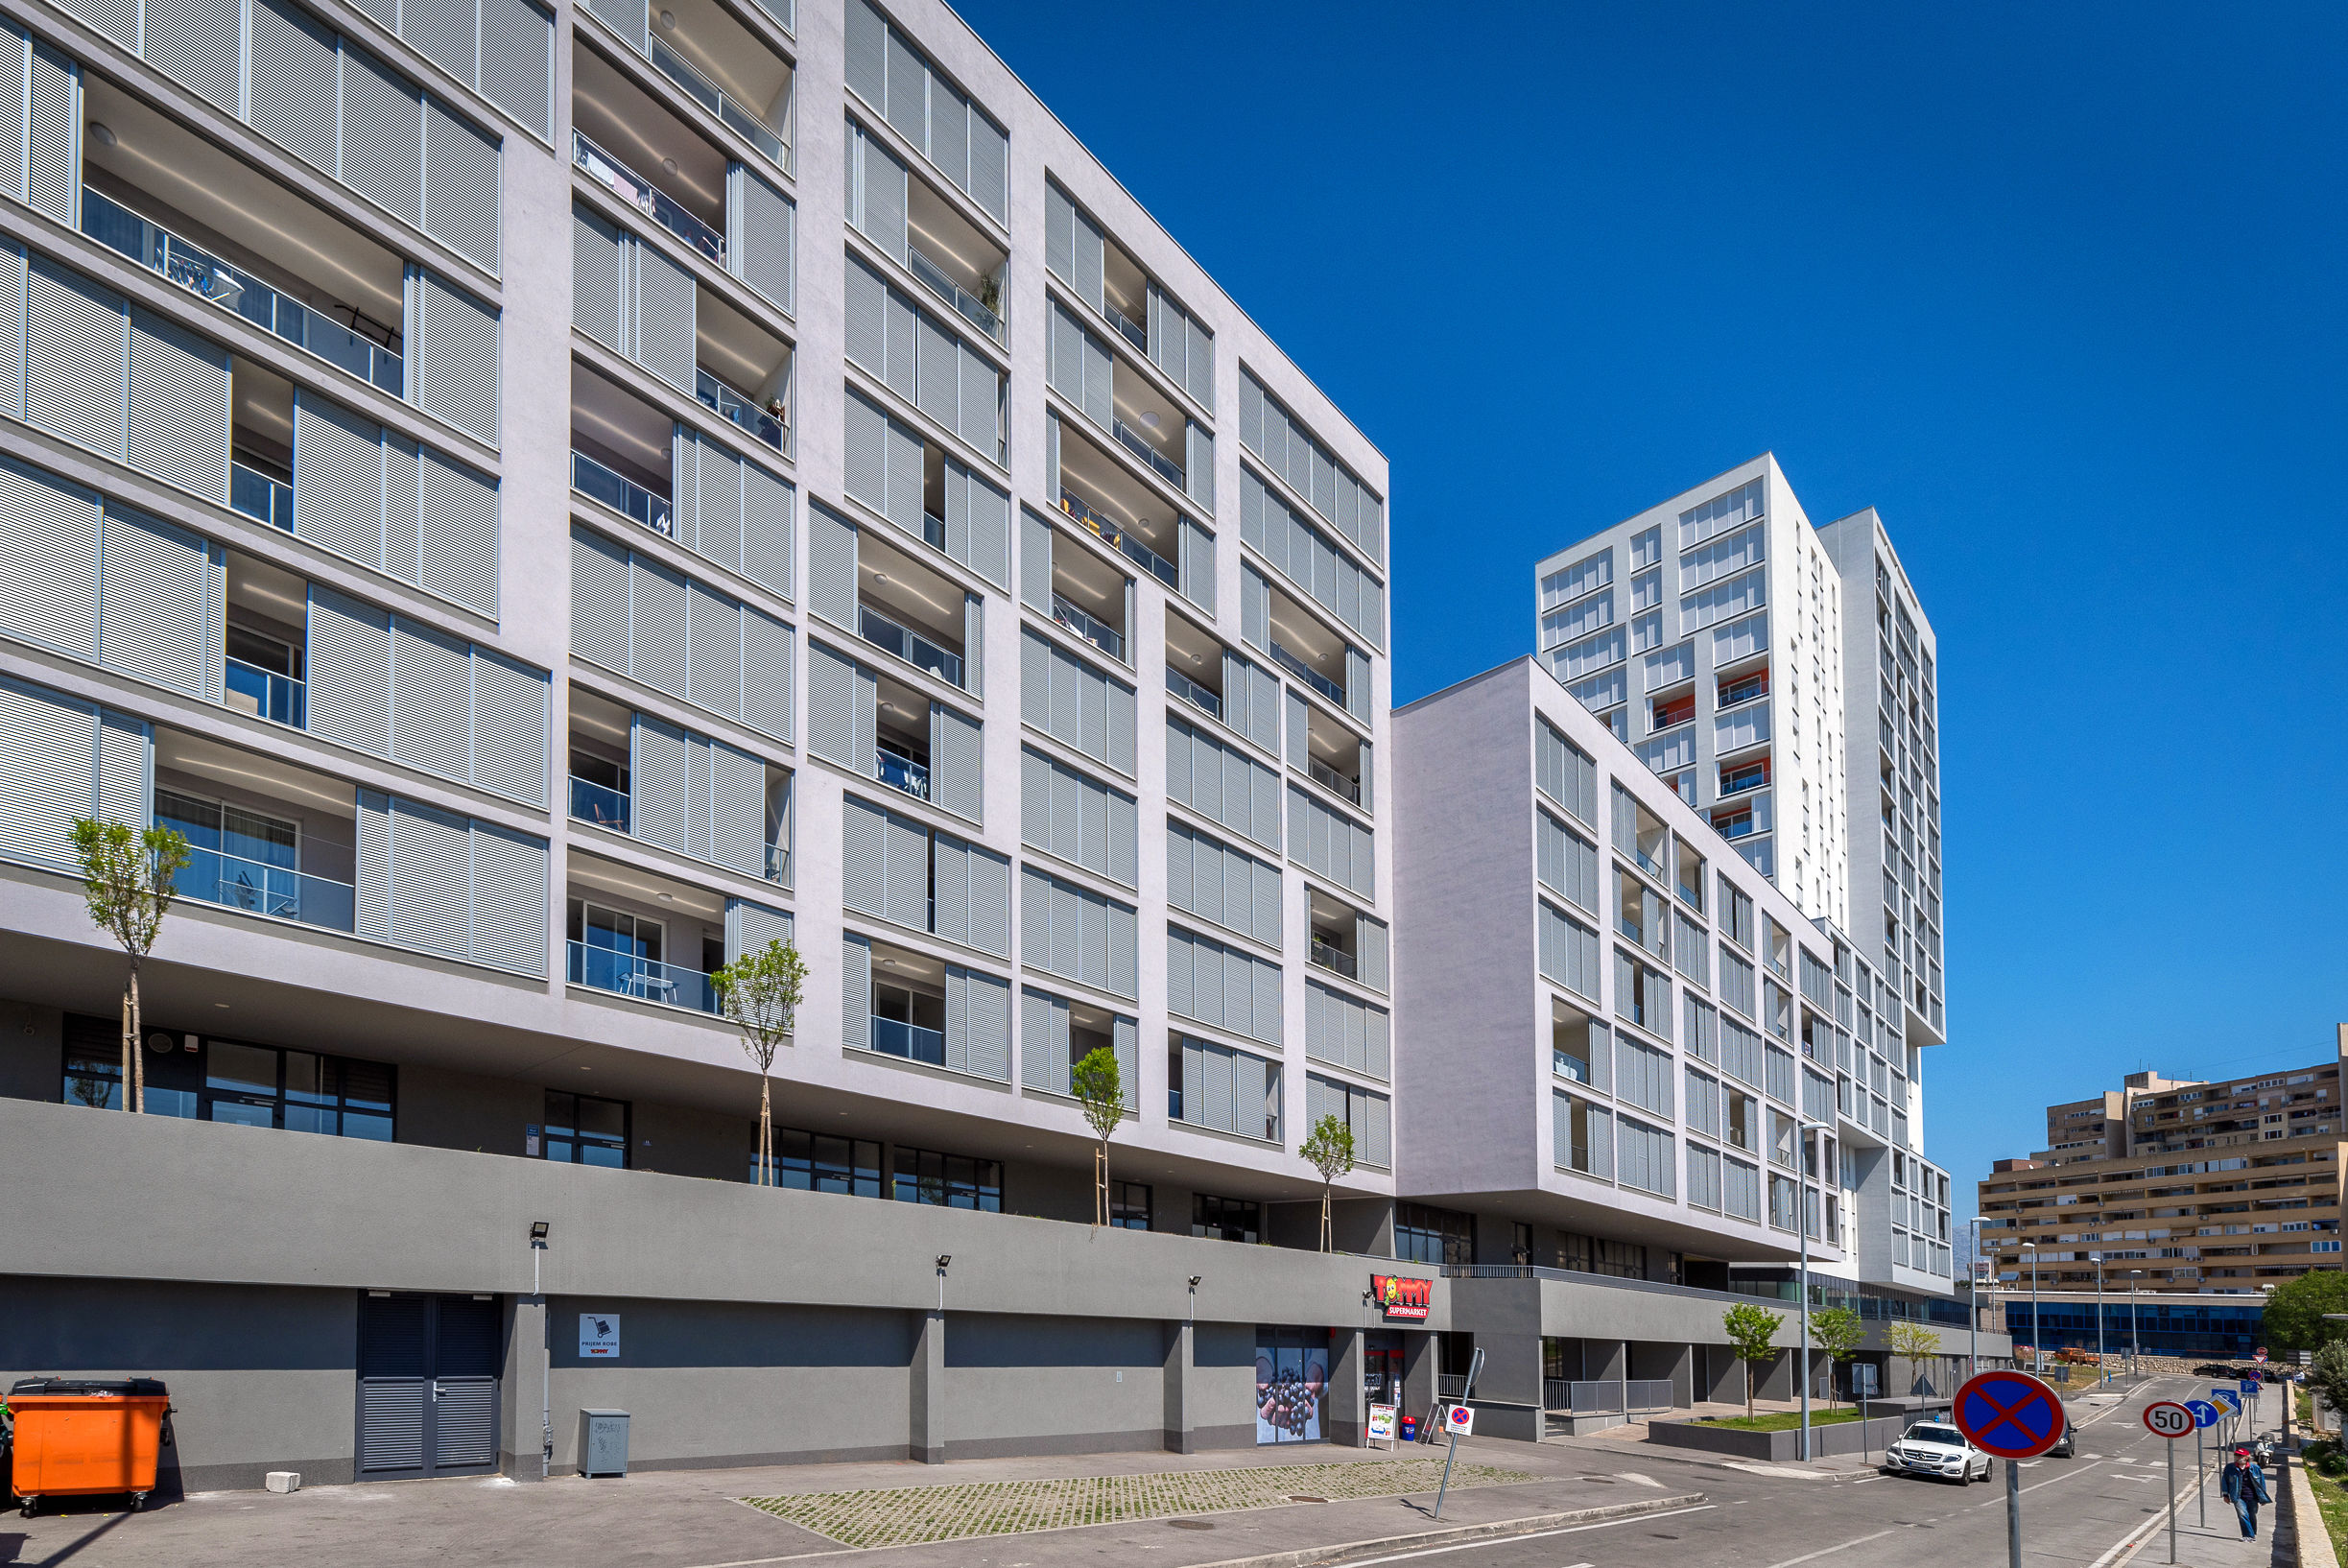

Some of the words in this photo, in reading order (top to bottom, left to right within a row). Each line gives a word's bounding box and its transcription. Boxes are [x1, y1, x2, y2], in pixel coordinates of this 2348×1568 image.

[1373, 1274, 1434, 1305] TOMMY
[1388, 1306, 1428, 1317] SUPERMARKET
[2154, 1410, 2183, 1431] 50
